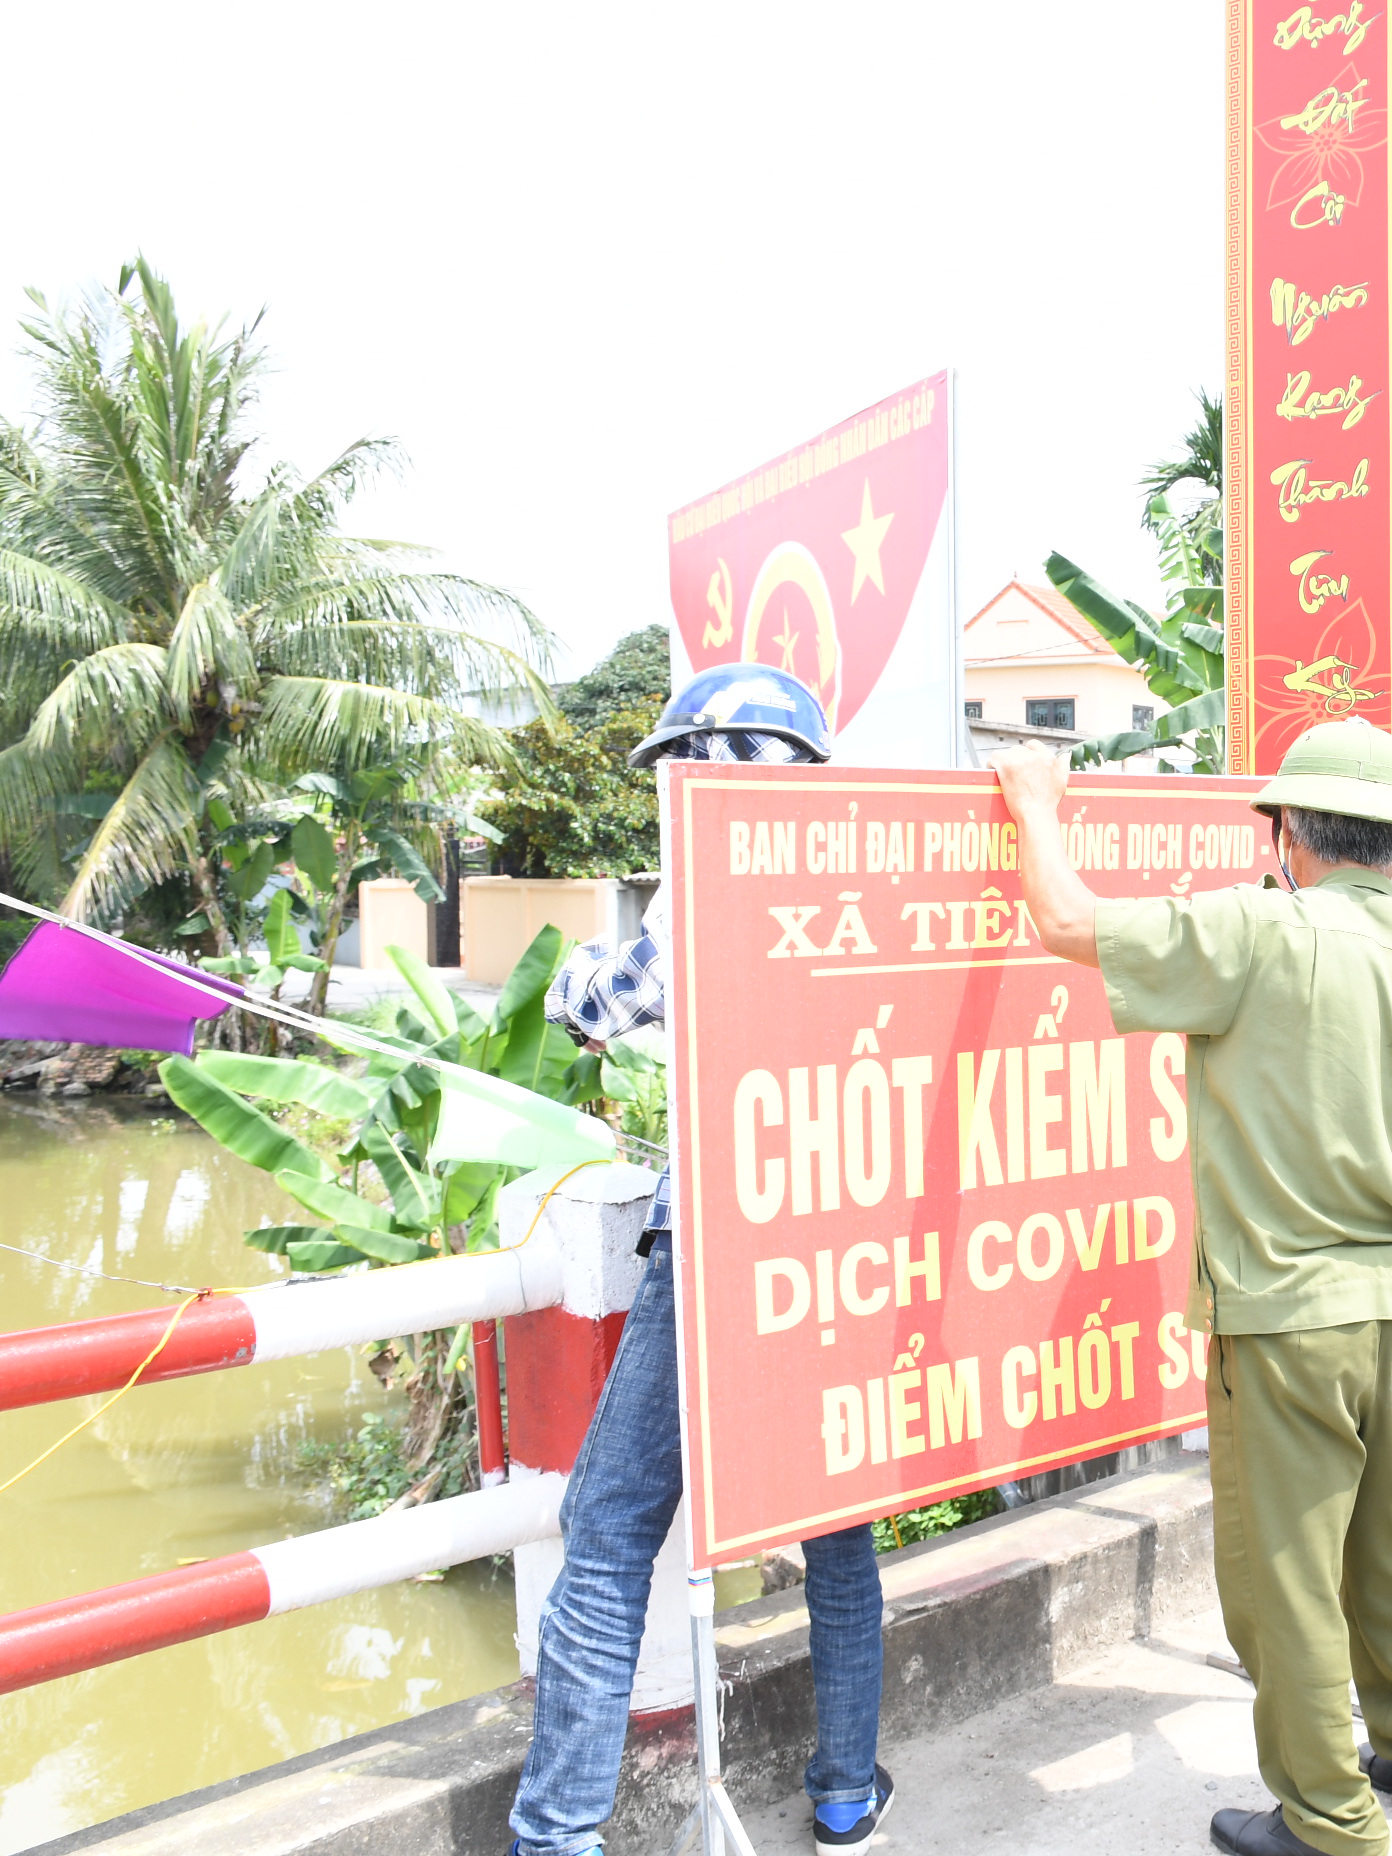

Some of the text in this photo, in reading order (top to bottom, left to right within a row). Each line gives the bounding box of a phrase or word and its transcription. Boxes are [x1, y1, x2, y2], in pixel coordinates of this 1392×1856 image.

[889, 396, 911, 440] CÁC
[1270, 458, 1370, 522] Thành
[730, 820, 797, 876] BAN
[806, 801, 857, 874] CHỈ
[866, 820, 914, 884] ĐẠI
[1126, 823, 1183, 880] DỊCH
[1189, 823, 1255, 870] COVID
[767, 891, 877, 959] XÃ
[734, 1004, 933, 1225] CHỐT
[956, 984, 1128, 1191] KIỂM
[754, 1195, 1177, 1347] DỊCH COVID
[821, 1332, 982, 1477] ĐIỂM
[1001, 1298, 1140, 1430] CHỐT
